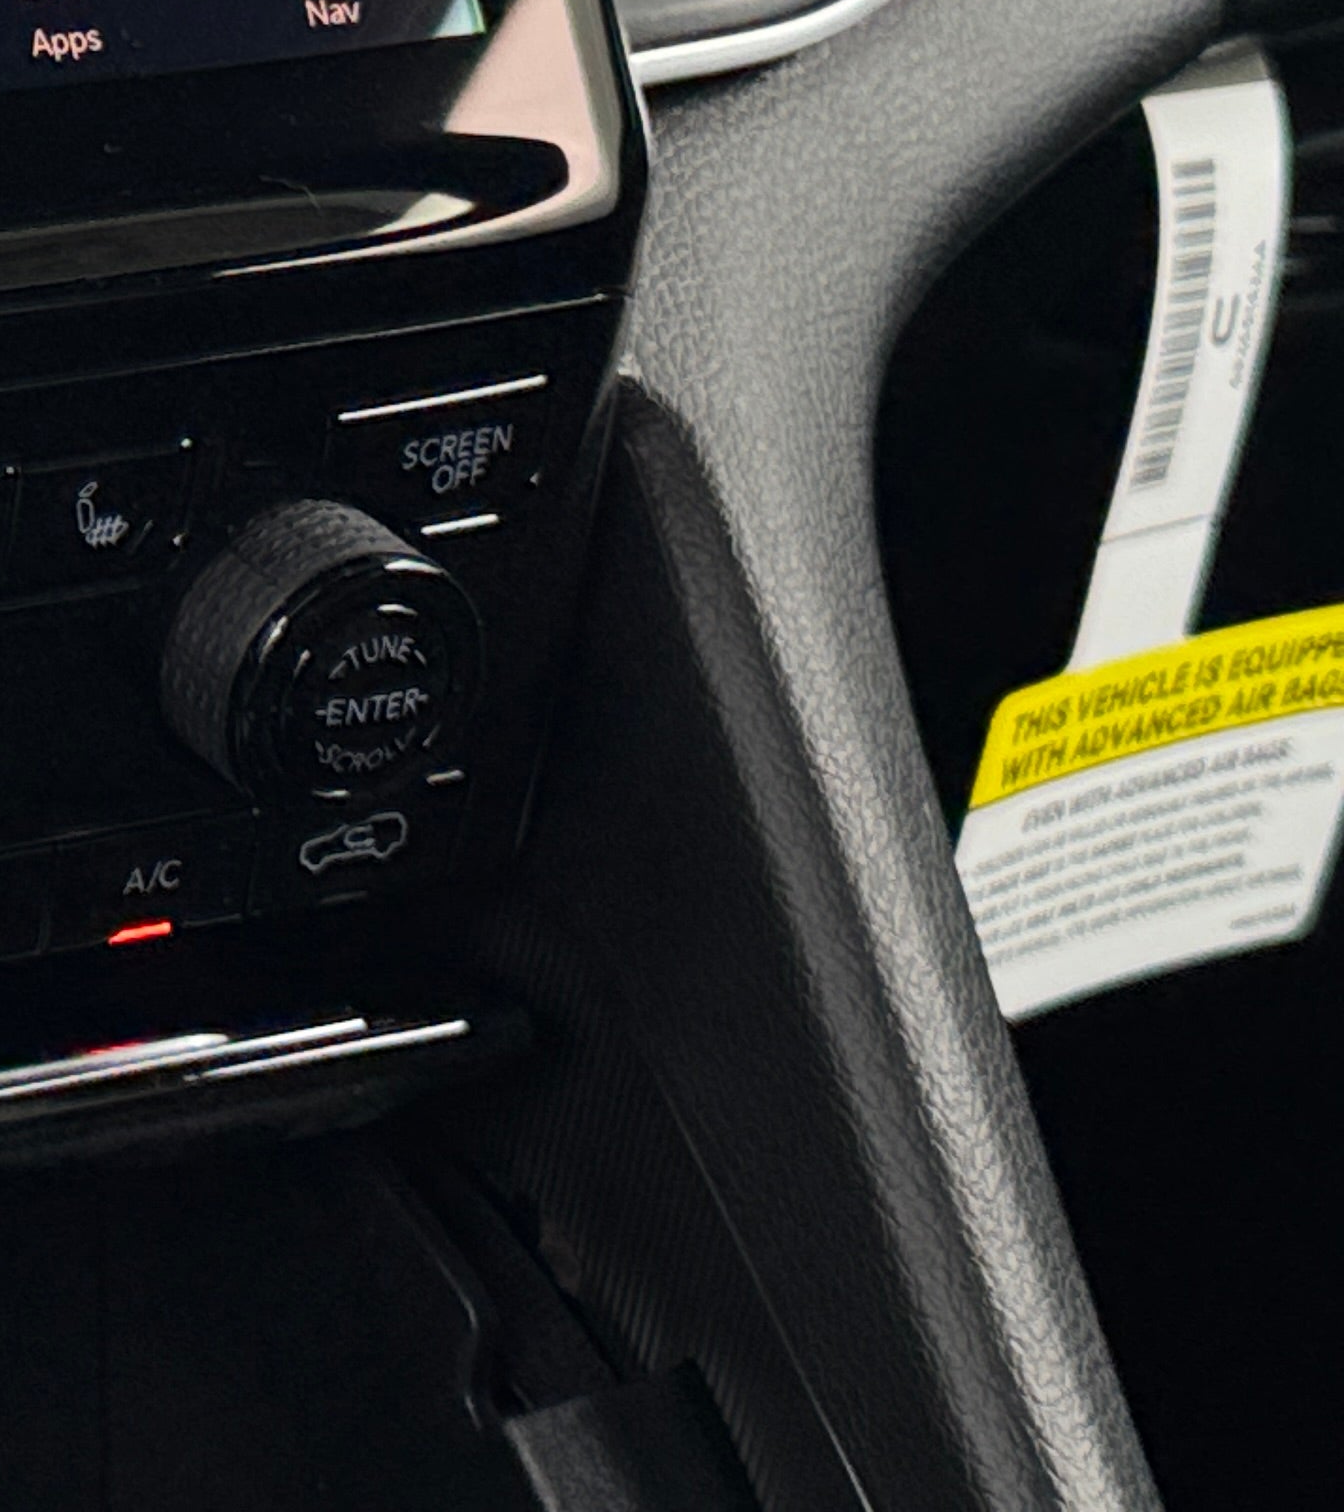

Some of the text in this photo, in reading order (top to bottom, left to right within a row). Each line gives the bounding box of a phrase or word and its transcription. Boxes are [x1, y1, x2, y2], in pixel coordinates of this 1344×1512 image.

[31, 28, 104, 62] Apps
[402, 423, 513, 471] SCREEN
[431, 458, 488, 491] OFF
[342, 635, 416, 671] TUNE
[1014, 696, 1070, 745] THIS
[1078, 664, 1191, 721] VEHICLE
[1193, 654, 1224, 687] IS
[1001, 667, 1344, 789] WITH ADVANCED AIR BAG
[123, 859, 183, 895] A/C
